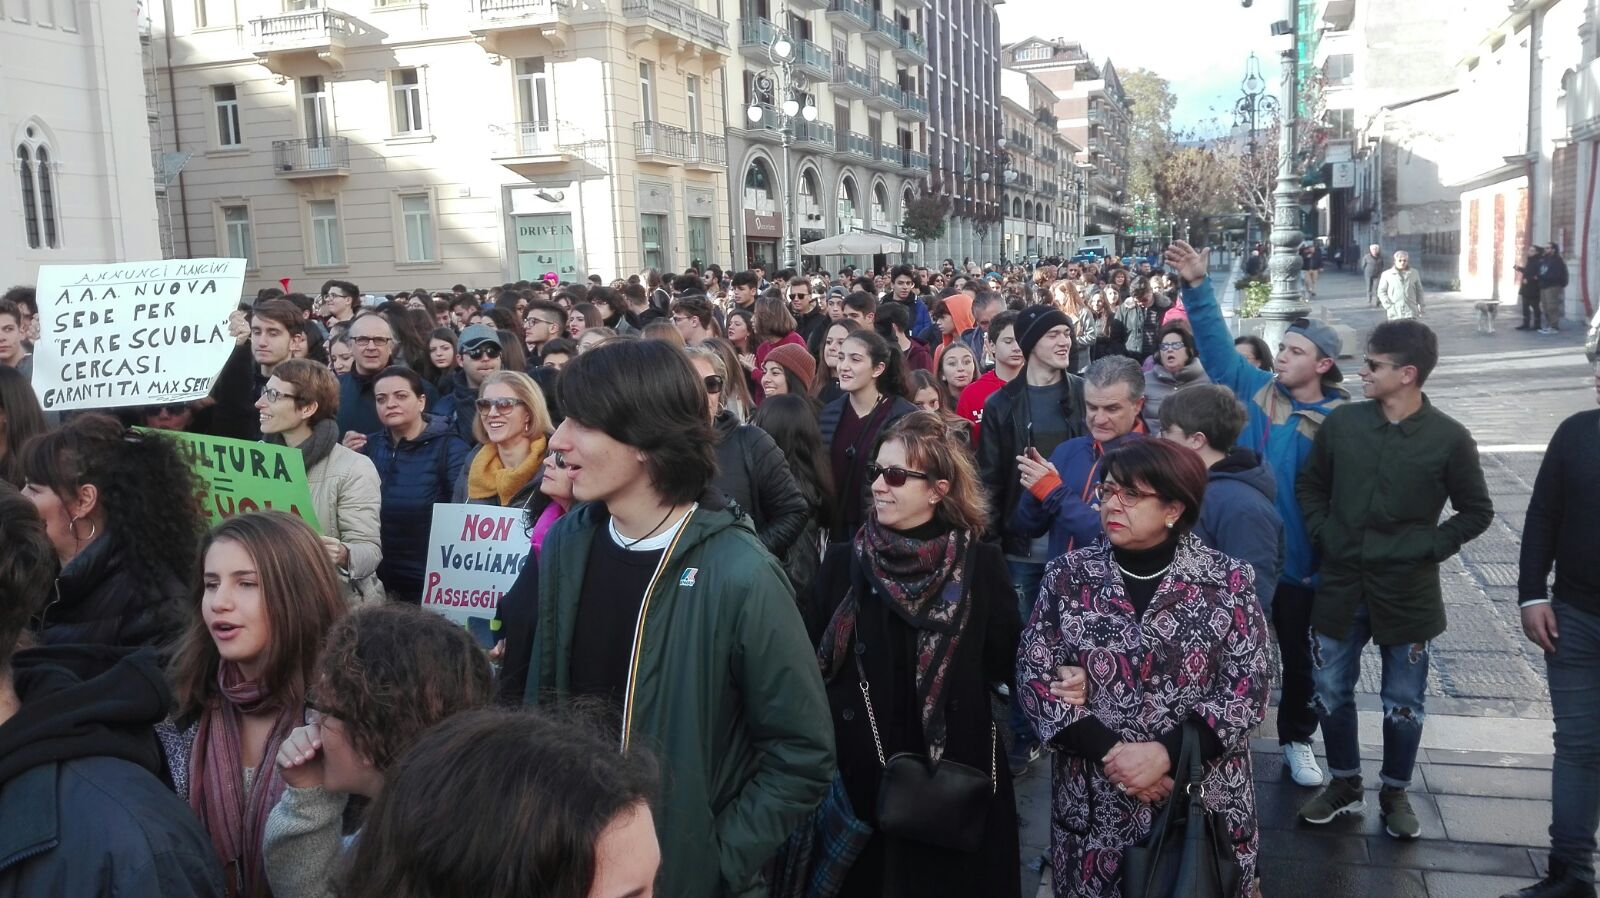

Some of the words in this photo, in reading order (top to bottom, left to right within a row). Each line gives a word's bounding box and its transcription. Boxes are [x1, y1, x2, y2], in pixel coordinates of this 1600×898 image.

[520, 225, 558, 236] DRIVE
[176, 261, 230, 276] MANCINI
[134, 279, 217, 297] NUOVA
[53, 308, 114, 333] SEDE
[133, 301, 175, 321] PER
[60, 355, 167, 382] CERCASI.
[43, 380, 140, 409] GARANTITA
[147, 380, 180, 394] MAX
[182, 377, 214, 393] SERI
[182, 440, 293, 483] ULTURA
[460, 513, 515, 542] NON
[424, 571, 505, 609] PASSEGGI
